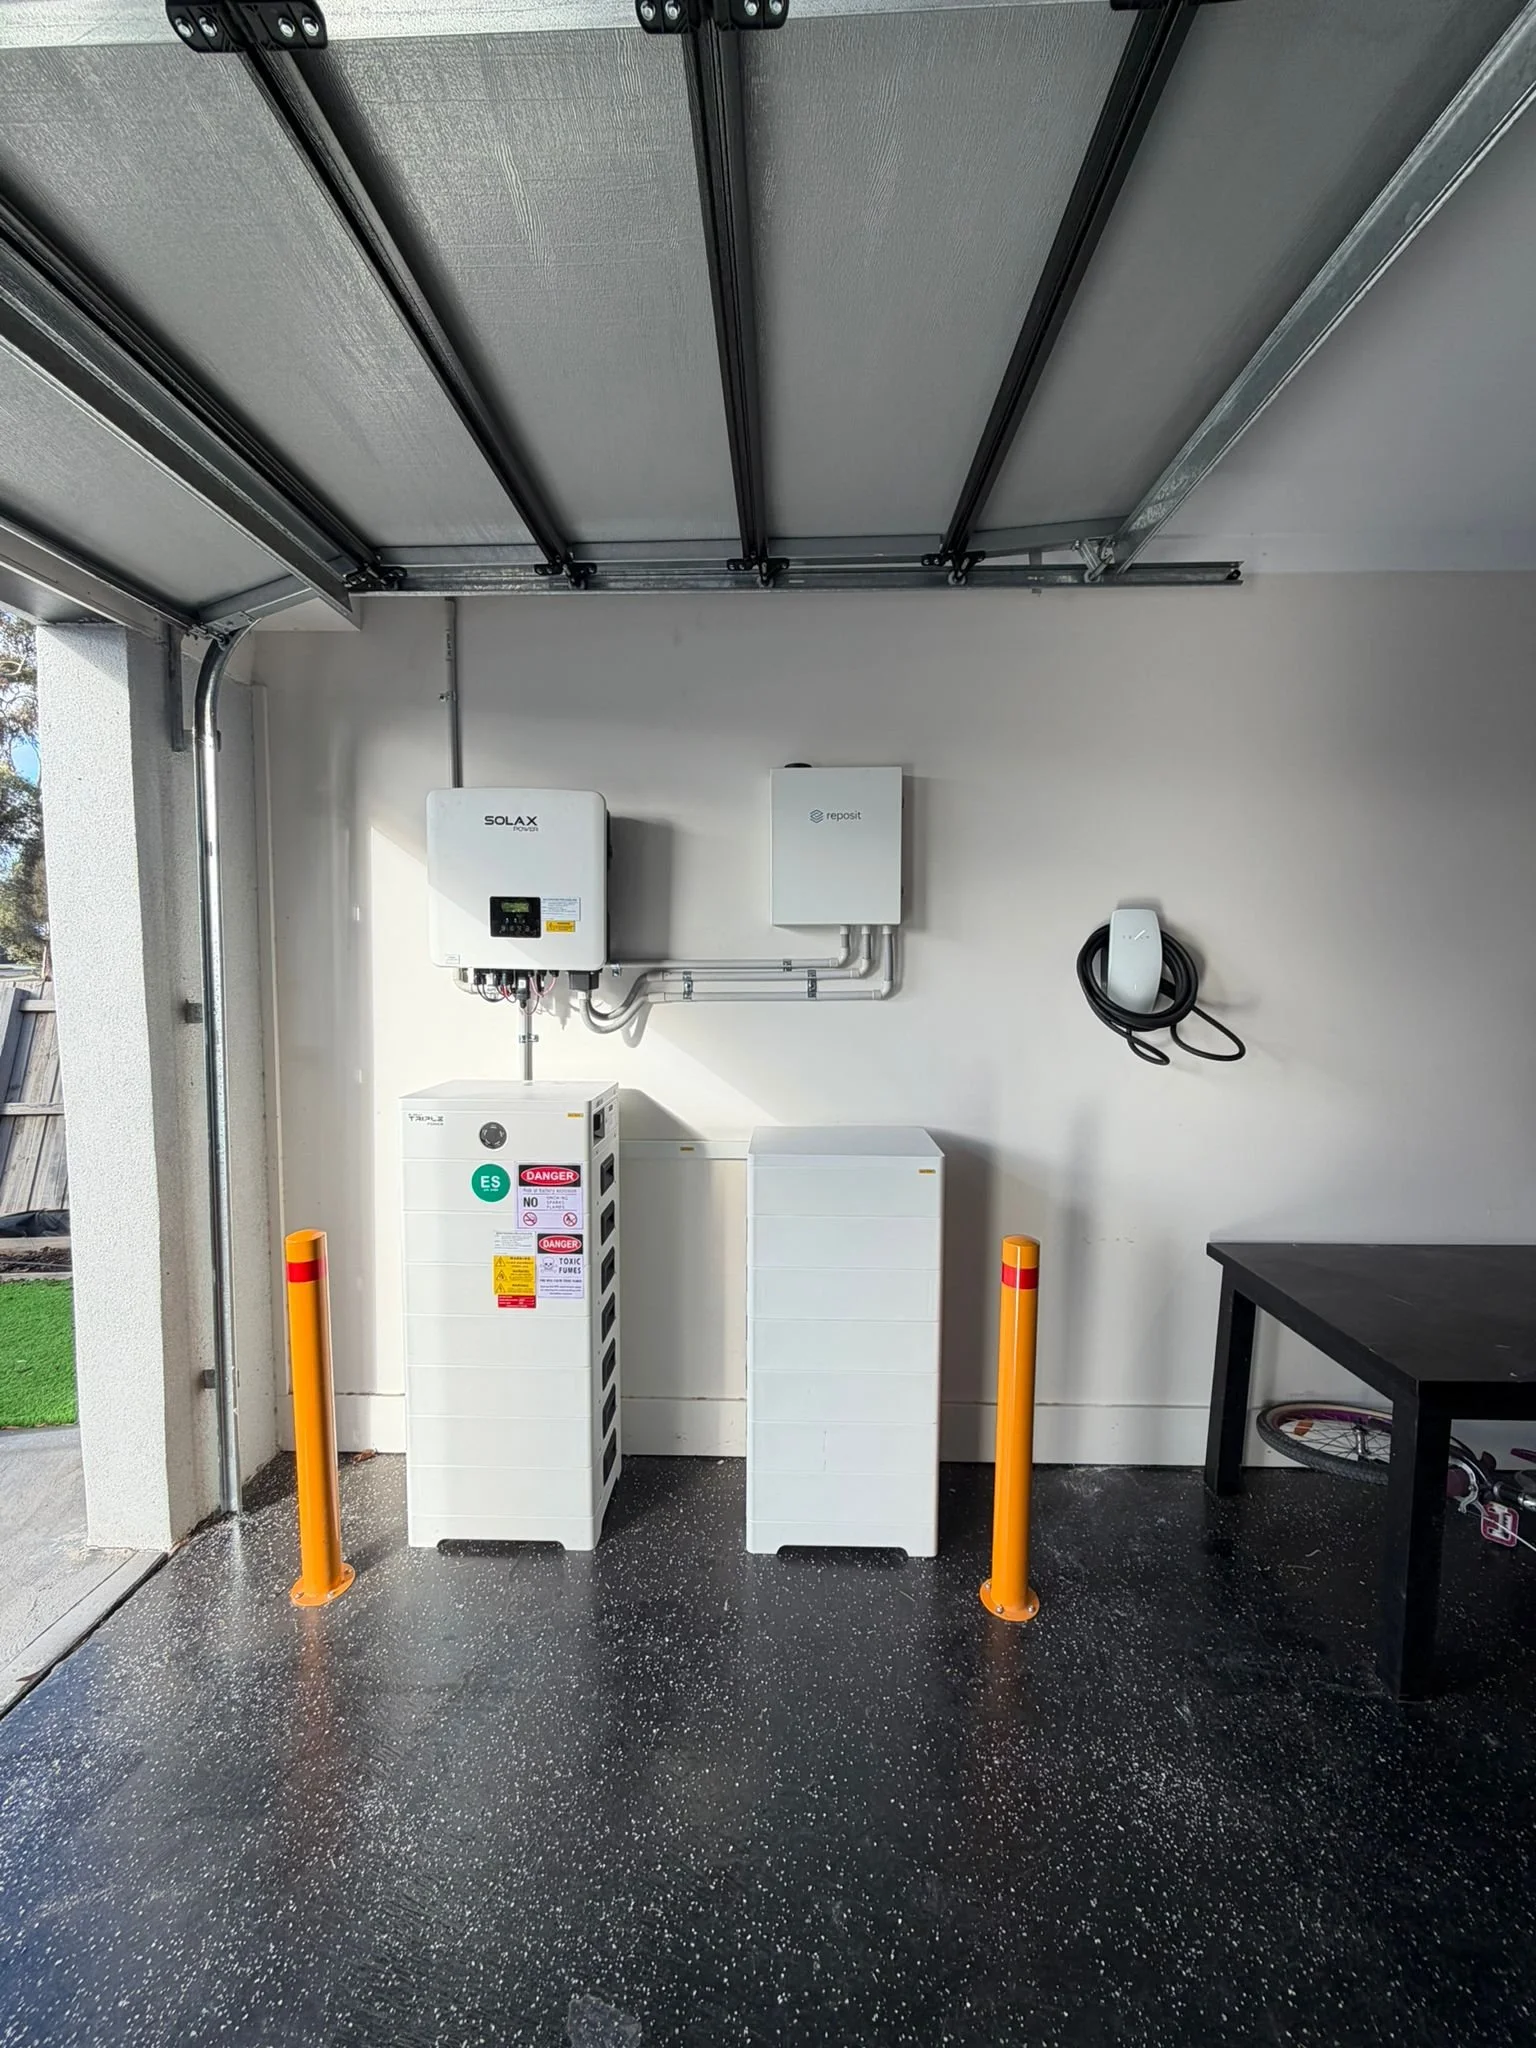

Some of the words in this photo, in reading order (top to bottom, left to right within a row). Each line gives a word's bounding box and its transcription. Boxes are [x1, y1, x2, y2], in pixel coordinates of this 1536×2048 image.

[484, 815, 538, 826] SOLAX
[826, 811, 862, 822] reposit
[480, 1175, 501, 1189] ES
[526, 1171, 575, 1182] DANGER
[523, 1196, 538, 1208] NO
[543, 1239, 578, 1249] DANGER
[559, 1257, 581, 1266] TOXIC
[558, 1267, 582, 1275] FUMES
